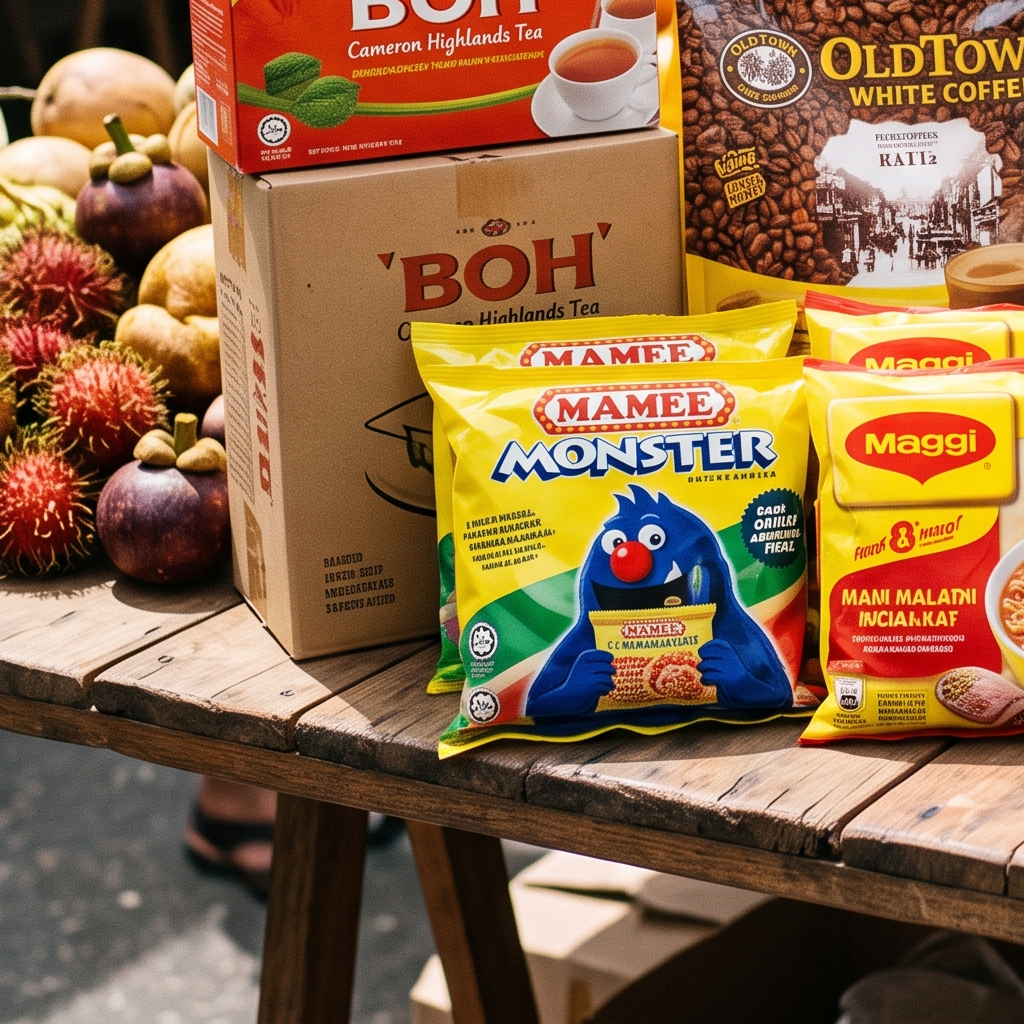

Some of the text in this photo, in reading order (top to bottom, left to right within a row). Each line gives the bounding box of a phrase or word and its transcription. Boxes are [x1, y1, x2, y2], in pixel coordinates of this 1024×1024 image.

[347, 23, 543, 59] Cameron Highlands Tea
[731, 34, 798, 58] OLDTOWN
[848, 83, 936, 107] WHITE
[569, 299, 600, 318] Tea
[541, 342, 694, 367] MAMEE
[557, 391, 714, 423] MAMEE
[491, 430, 779, 482] MONSTER
[865, 429, 977, 457] Maggi
